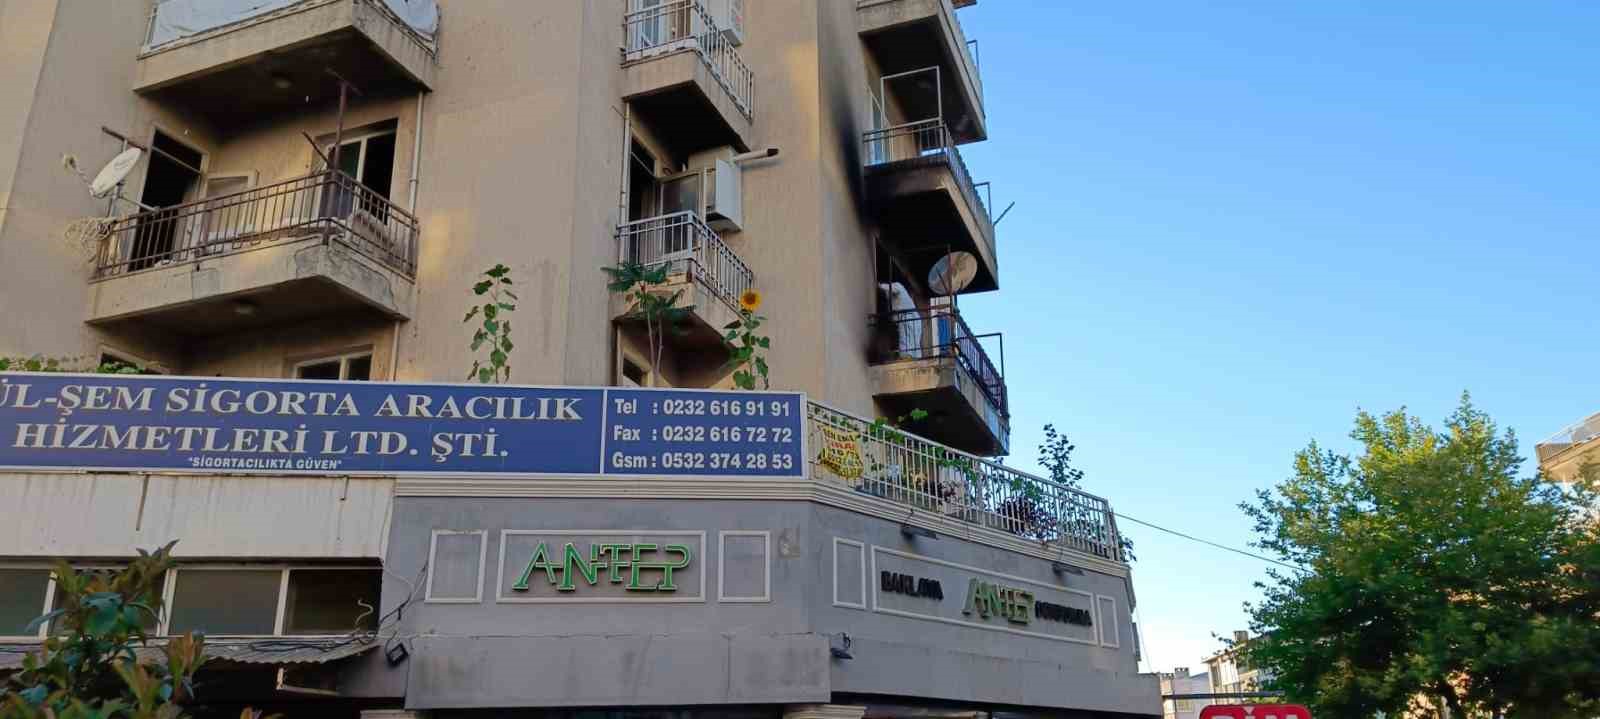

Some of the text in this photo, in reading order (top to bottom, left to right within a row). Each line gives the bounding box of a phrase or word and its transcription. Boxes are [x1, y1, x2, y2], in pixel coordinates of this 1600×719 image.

[165, 383, 360, 417] SİGORTA
[374, 394, 583, 420] ARACILIK
[614, 398, 637, 415] Tel
[663, 400, 705, 416] 0232
[710, 400, 741, 416] 616
[746, 401, 764, 416] 91
[771, 402, 790, 417] 91
[11, 417, 508, 463] HİZMETLERİ LTD. ŞTİ.
[613, 425, 640, 441] Fax
[662, 426, 705, 442] 0232
[710, 426, 741, 442] 616
[746, 427, 767, 442] 72
[772, 427, 793, 443] 72
[612, 452, 648, 468] Gsm
[662, 452, 705, 468] 0532
[710, 453, 741, 468] 374
[746, 453, 767, 468] 28
[772, 454, 793, 469] 53
[512, 542, 692, 592] ANTEP
